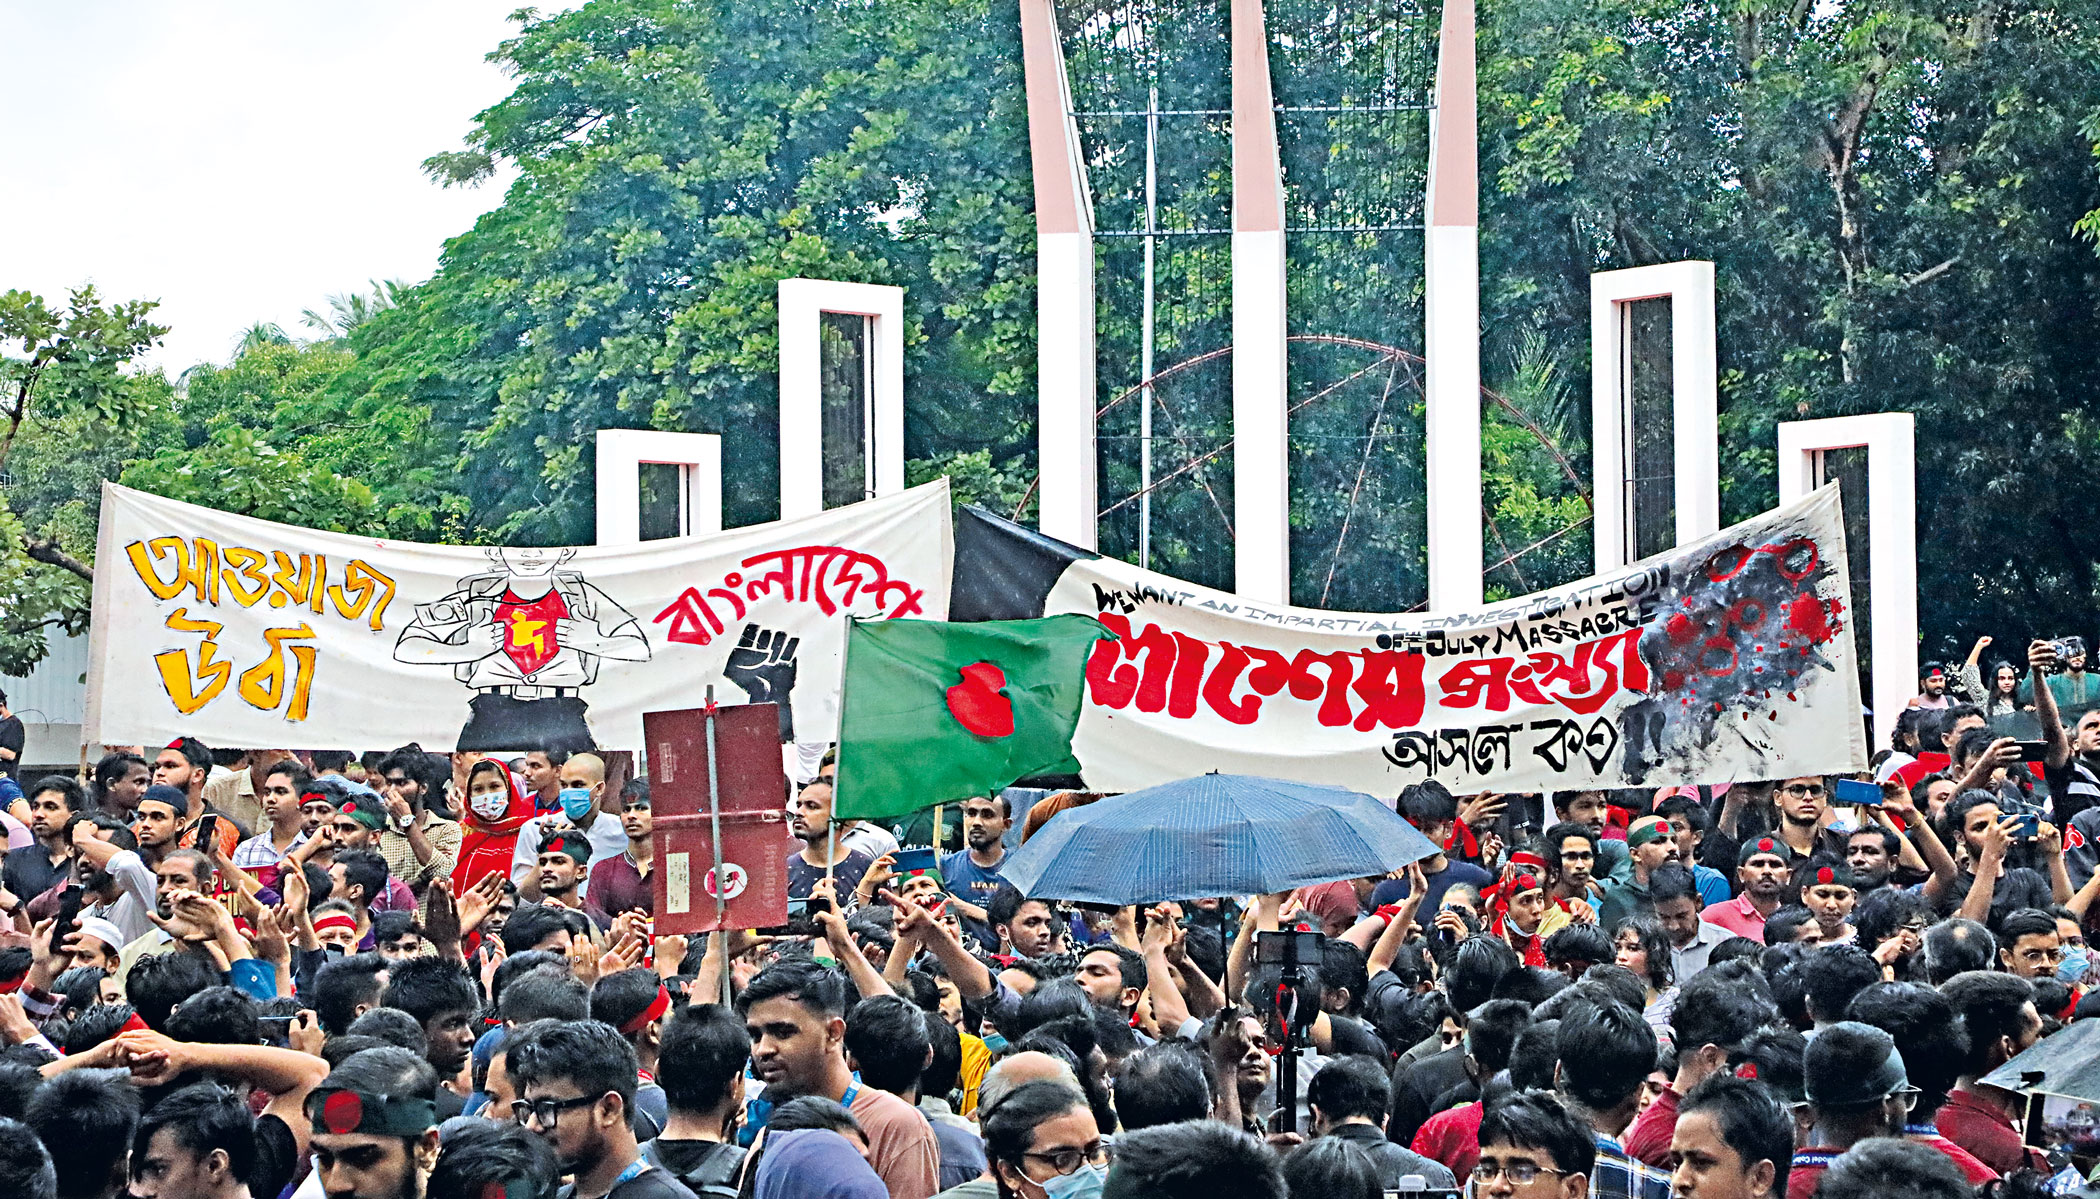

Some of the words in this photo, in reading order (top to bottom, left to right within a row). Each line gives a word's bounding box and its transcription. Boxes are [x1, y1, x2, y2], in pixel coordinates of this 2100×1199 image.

[652, 545, 923, 646] বাংলাদেশ
[1092, 582, 1136, 614] WE
[1127, 581, 1196, 607] WANT
[1198, 599, 1239, 614] AN
[1244, 606, 1407, 632] IMPARTIAL
[1422, 562, 1671, 630] INVESTIGATION
[1426, 629, 1491, 659] JULY
[1492, 593, 1660, 656] MASSACRE
[1086, 612, 1426, 732] লাশের
[1438, 626, 1650, 715] সংখ্যা
[1382, 722, 1524, 777] আসলে
